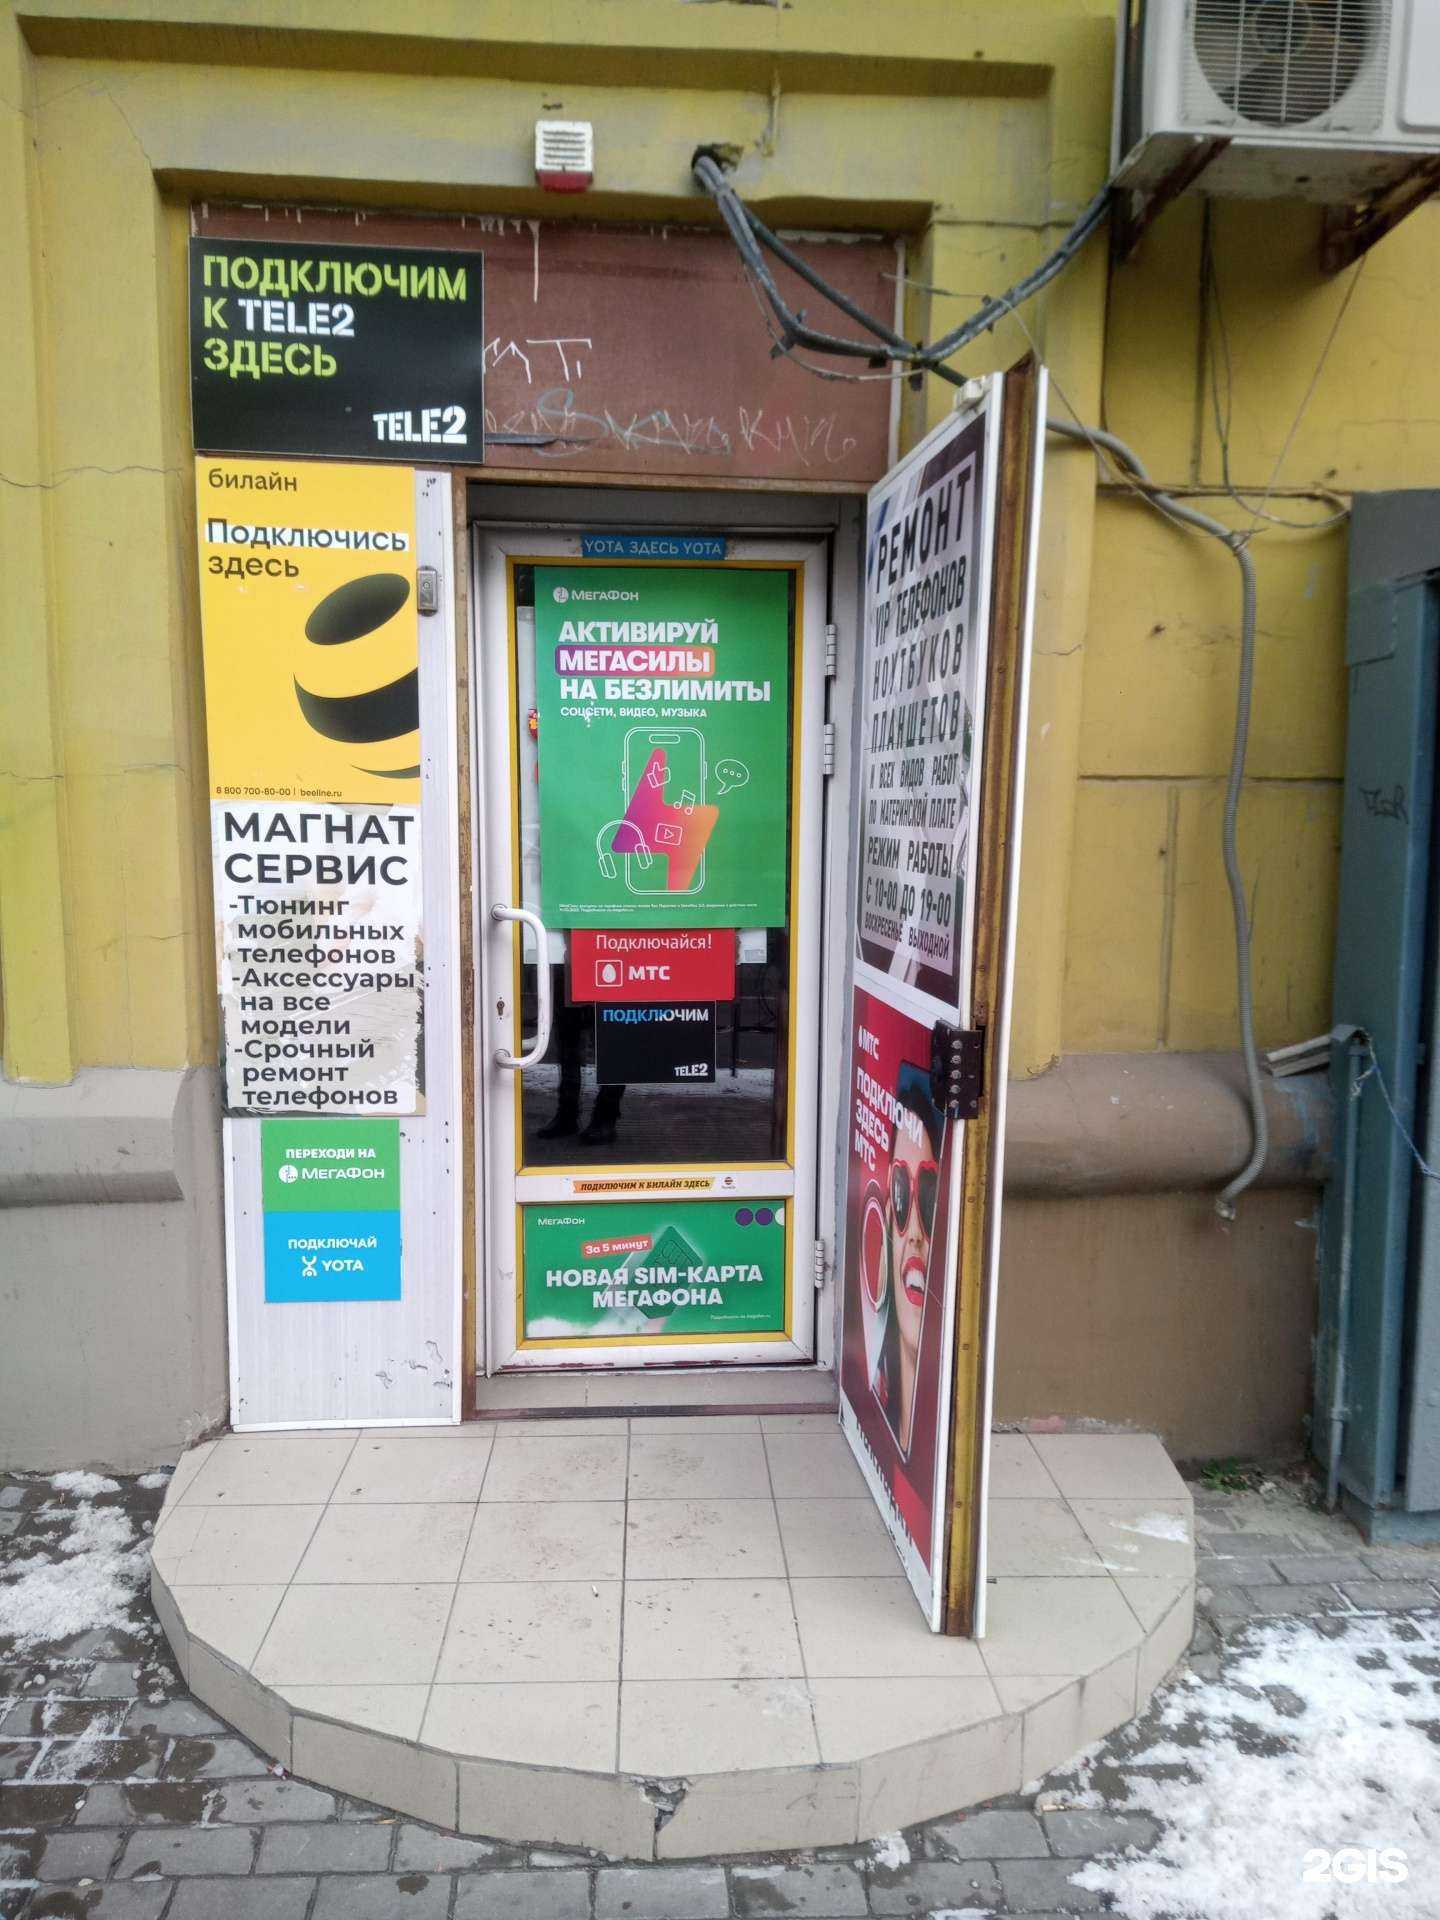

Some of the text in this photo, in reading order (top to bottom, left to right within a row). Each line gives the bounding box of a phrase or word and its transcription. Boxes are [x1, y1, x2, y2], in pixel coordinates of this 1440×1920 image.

[203, 255, 467, 301] ПОДКЛЮЧИМ
[203, 297, 355, 337] К TELE2
[203, 337, 337, 380] ЗДЕСЬ
[372, 405, 467, 444] TELE2
[208, 468, 297, 491] билайн
[207, 518, 407, 551] Подключись
[876, 464, 971, 593] РЕМОНТ
[584, 539, 722, 555] YOTA ЗДЕСЬ YOTA
[208, 556, 300, 580] здесь
[875, 555, 966, 648] VIP ТЕЛЕФОНОВ
[558, 617, 719, 644] АКТИВИРУЙ
[559, 650, 710, 673] МЕГАСИЛЫ
[873, 623, 963, 700] НОУТБУКОВ
[559, 678, 771, 702] НА БЕЗЛИМИТЫ
[560, 706, 707, 719] СОЦСЕТИ, ВИДЕО, МУЗЫКА
[872, 691, 960, 753] ПЛАНШЕТОВ
[879, 761, 895, 789] ВСЕХ
[900, 758, 924, 792] ВИДОВ
[931, 753, 958, 786] РАБОТ
[224, 786, 242, 795] 800
[244, 787, 291, 796] 700-80-00
[300, 788, 342, 798] beeline.ru
[880, 792, 928, 828] МАТЕРИНСКОЙ
[929, 798, 956, 829] ПЛАТЕ
[224, 811, 414, 845] МАГНАТ
[224, 853, 408, 885] СЕРВИС
[867, 836, 954, 879] РЕЖИМ РАБОТЫ
[229, 895, 350, 916] -Тюнинг
[866, 876, 951, 927] С 10-00 ДО 19-00
[238, 919, 404, 941] мобильных
[865, 911, 949, 960] ВОСКРЕСЕНЬЕ ВЫХОДНОЙ
[596, 933, 712, 952] Подключайся!
[237, 944, 396, 968] телефонов
[232, 968, 414, 992] -Аксессуары
[628, 965, 671, 981] МТС
[240, 996, 331, 1011] на все
[603, 1008, 709, 1024] ПОДКЛЮЧИМ
[241, 1020, 351, 1038] модели
[234, 1039, 375, 1063] -Срочный
[862, 1028, 879, 1060] МТС
[242, 1066, 349, 1086] ремонт
[674, 1063, 709, 1077] TELE2
[242, 1086, 398, 1109] телефонов
[857, 1066, 923, 1149] ПОДКЛЮЧИ
[856, 1099, 889, 1152] ЗДЕСЬ
[285, 1148, 376, 1160] ПЕРЕХОДИ НА
[855, 1129, 876, 1171] МТС
[581, 1182, 637, 1191] ПОДКЛЮЧИМ
[646, 1179, 681, 1189] БИЛАЙН
[684, 1180, 710, 1189] ЗДЕСЬ
[287, 1235, 378, 1250] ПОДКЛЮЧАЙ
[585, 1239, 648, 1254] За 5 минут
[321, 1259, 364, 1272] YOTA
[546, 1265, 763, 1288] НОВАЯ SIM-КАРТА
[593, 1288, 723, 1308] МЕГАФОНА
